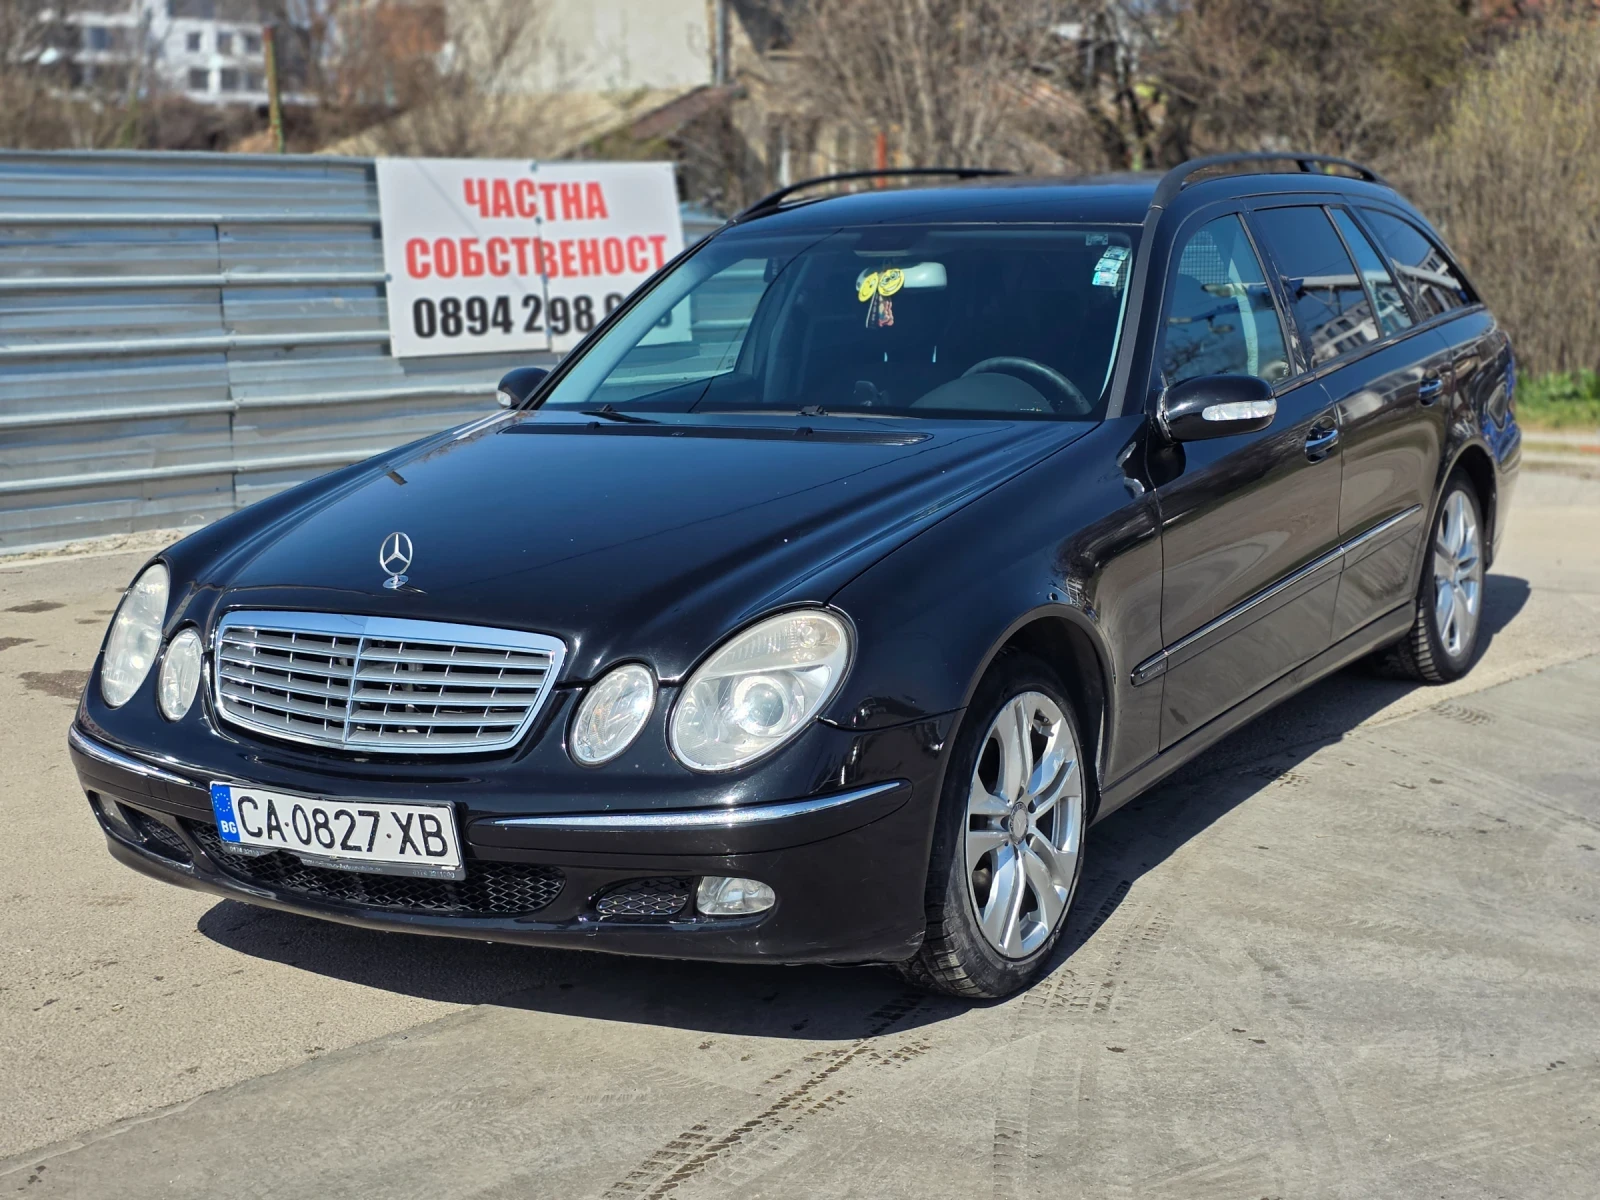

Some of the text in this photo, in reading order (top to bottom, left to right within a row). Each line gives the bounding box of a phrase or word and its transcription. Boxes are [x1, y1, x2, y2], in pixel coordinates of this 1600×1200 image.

[463, 177, 609, 222] ЧАСТНА
[405, 234, 668, 280] СОБСТВЕНОСТ
[412, 295, 514, 339] 0894
[522, 293, 596, 337] 298
[220, 820, 238, 834] BG
